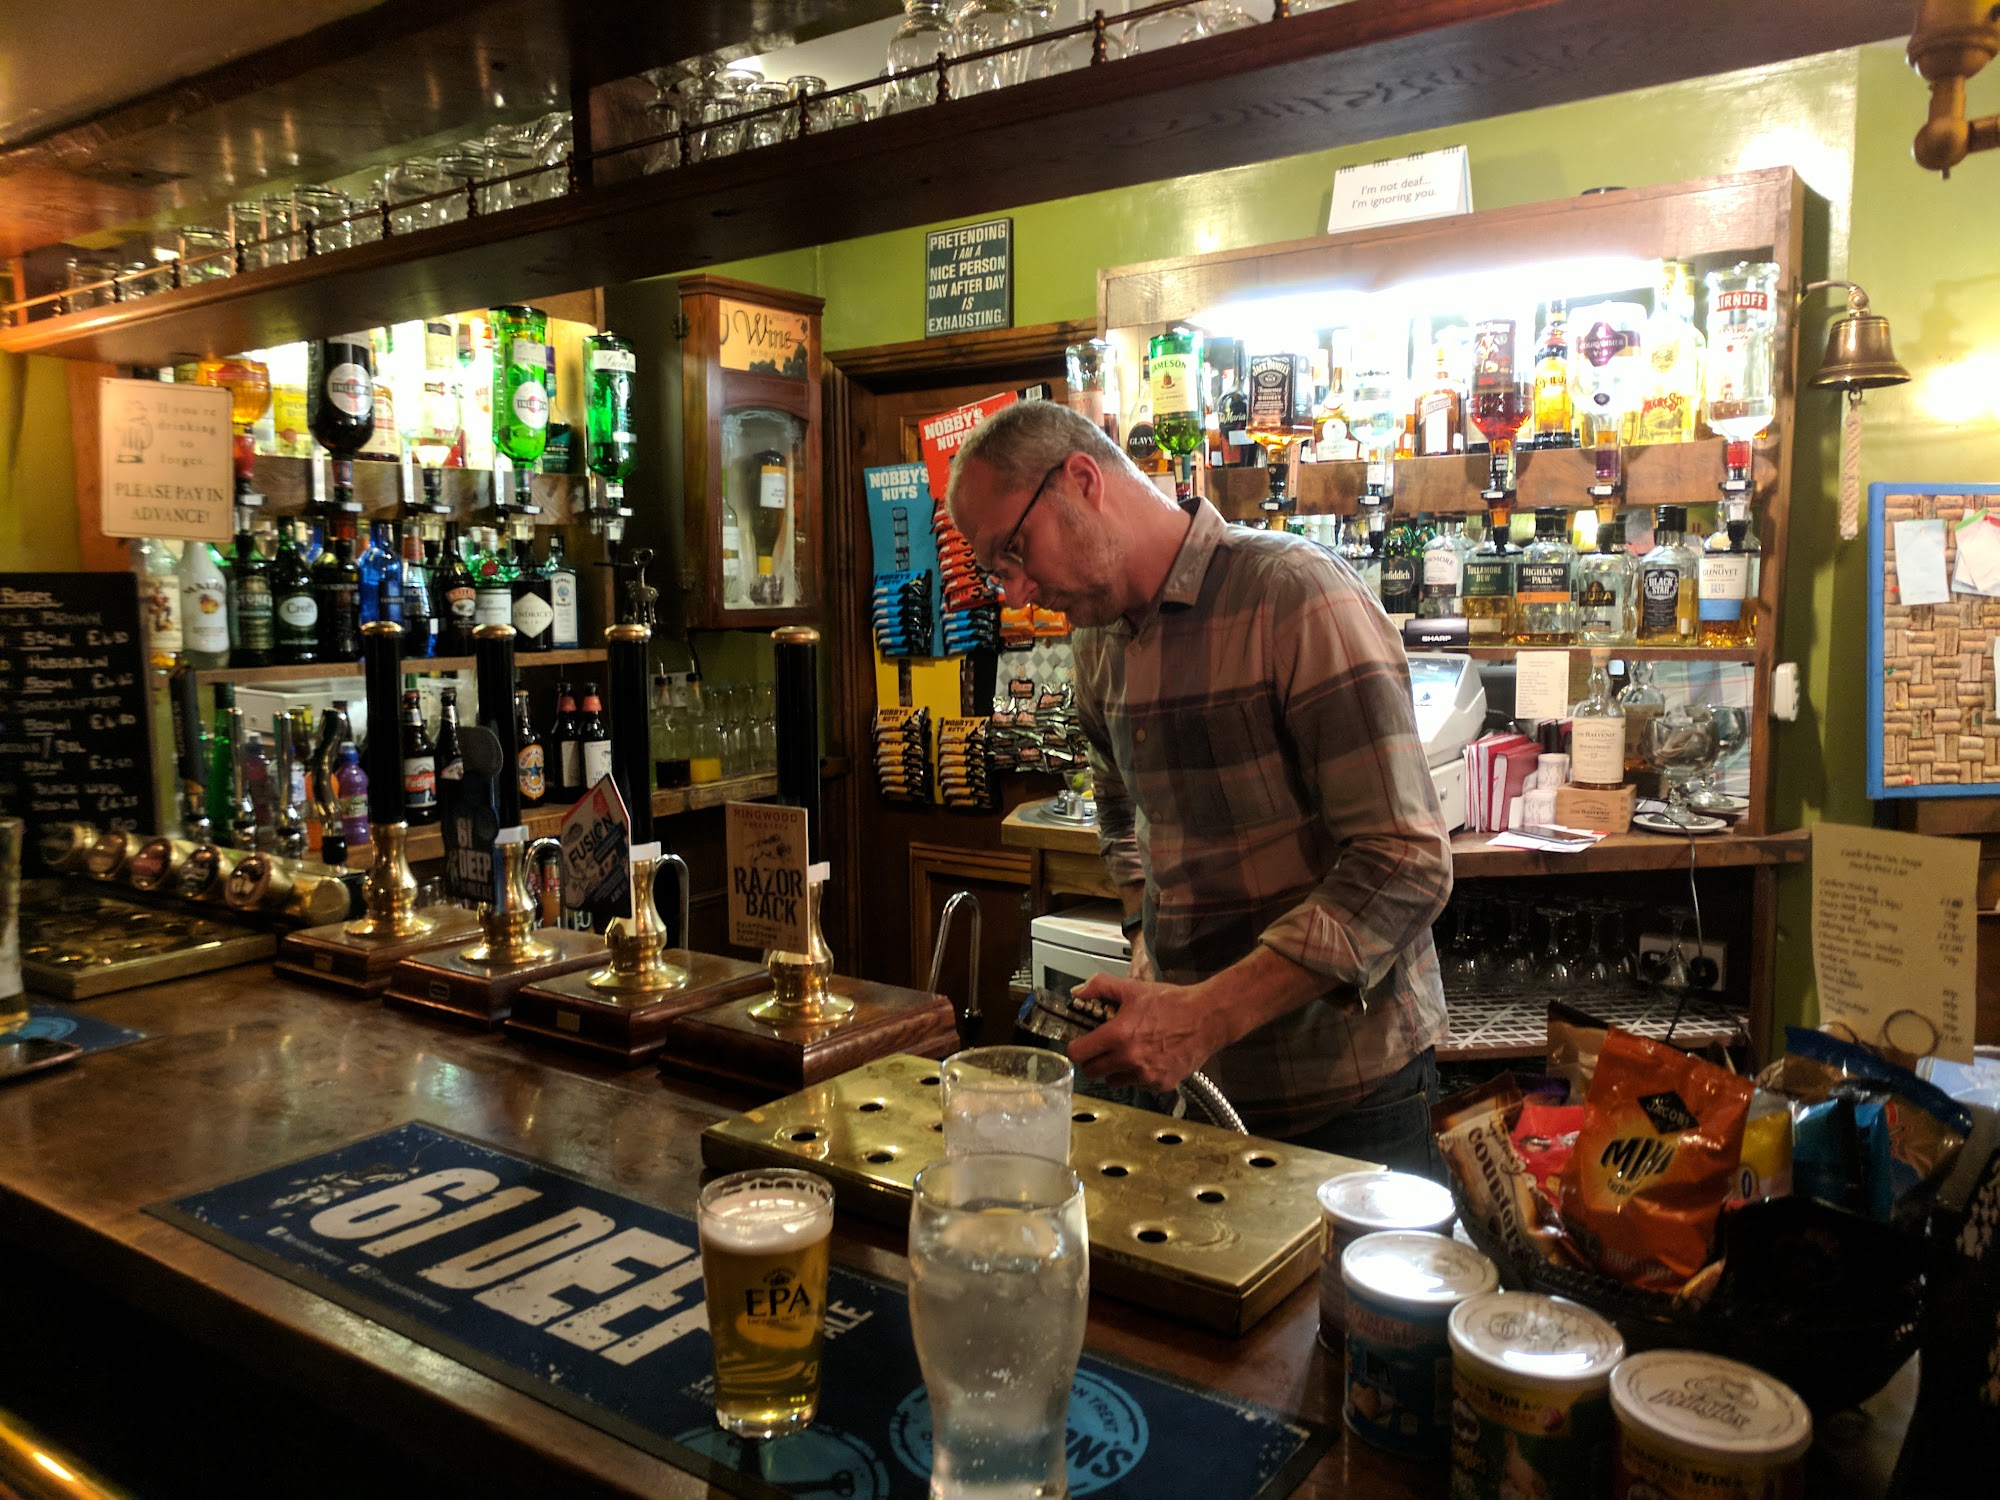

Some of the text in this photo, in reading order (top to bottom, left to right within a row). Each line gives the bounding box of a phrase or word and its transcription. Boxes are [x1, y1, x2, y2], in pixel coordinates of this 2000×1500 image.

[1361, 176, 1431, 195] I'm not deaf...
[1352, 189, 1437, 209] I'm ignoring you.
[930, 223, 1006, 251] PRETENDING
[952, 245, 982, 261] I AM A
[930, 255, 1006, 281] NICE PERSON
[929, 274, 1005, 300] DAY AFTER DAY
[961, 296, 975, 311] IS
[733, 309, 793, 349] Wine
[928, 308, 1005, 332] EXHAUSTING.
[1151, 359, 1187, 374] JAMESON
[1252, 358, 1291, 377] JACK DANIEL'S
[923, 407, 984, 441] NOBBY'S
[1226, 411, 1246, 423] Maria
[157, 419, 216, 436] drinking
[1130, 436, 1156, 445] GLAYV
[869, 465, 929, 488] NOBBY'S
[115, 482, 225, 502] PLEASE PAY IN
[881, 485, 918, 501] NUTS
[131, 506, 211, 524] ADVANCE!
[1466, 564, 1502, 575] TULLAMORE
[1523, 567, 1564, 577] HIGHLAND
[1702, 568, 1739, 577] GLENLIVET
[1532, 576, 1553, 585] PARK
[1648, 577, 1675, 587] BLACK
[1652, 585, 1671, 596] STAR
[1421, 634, 1452, 643] SHARP
[733, 808, 798, 823] RINGWOOD
[568, 811, 615, 868] FUSION
[458, 848, 492, 884] DEEP
[733, 866, 803, 898] RAZOR
[745, 892, 797, 926] BACK
[309, 1167, 544, 1258] 61
[745, 1283, 811, 1316] EPA
